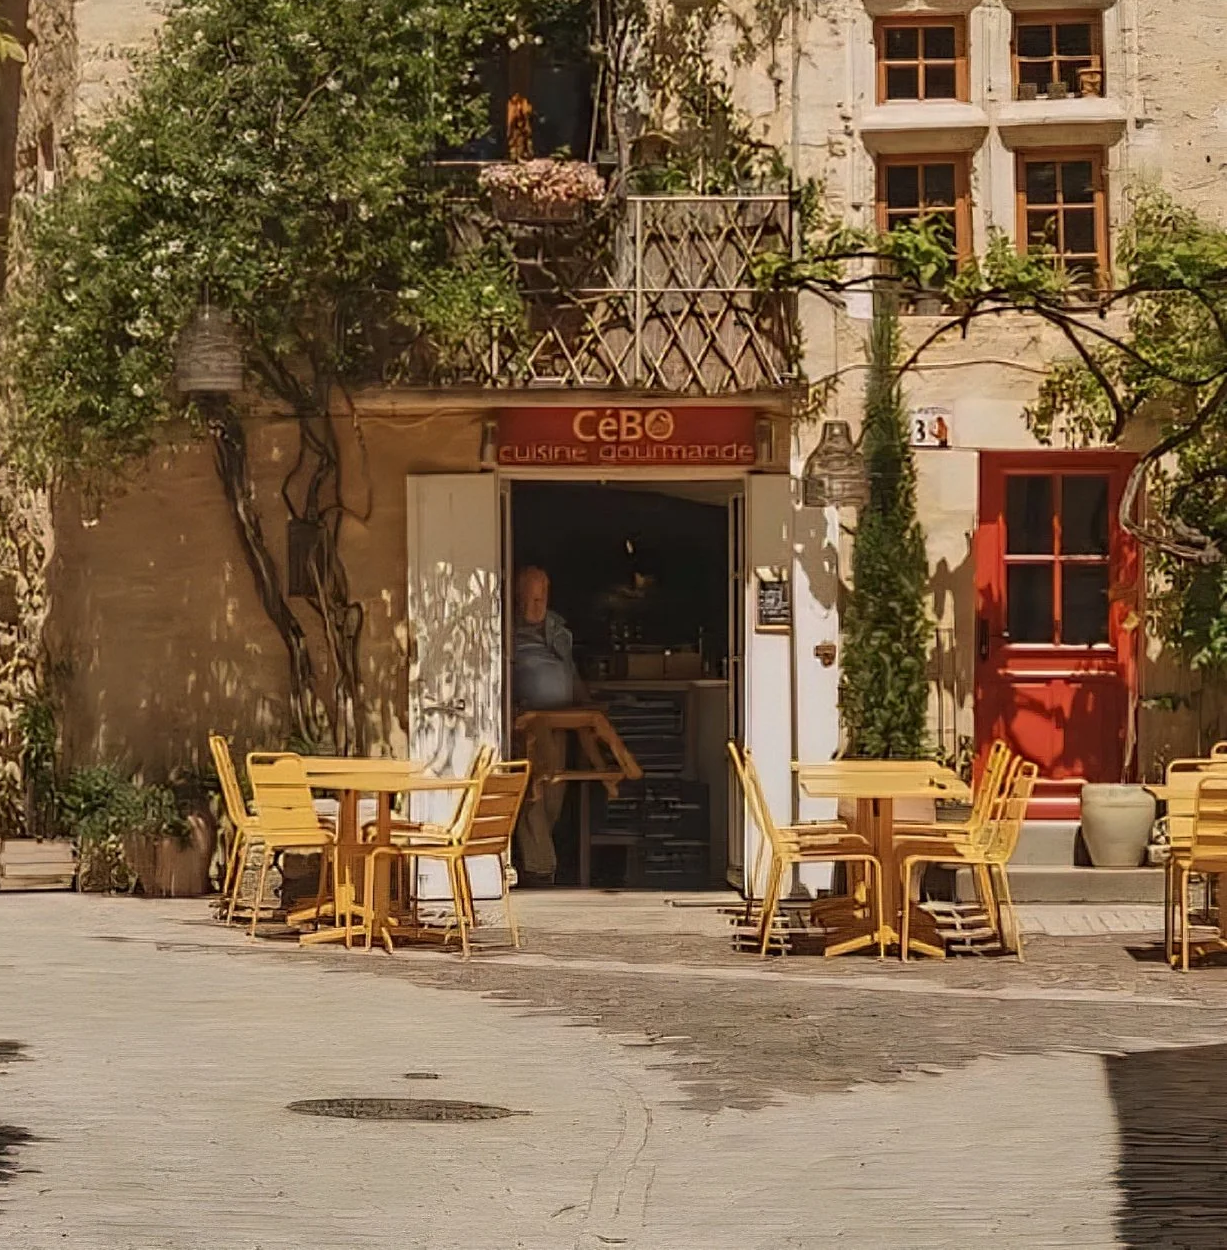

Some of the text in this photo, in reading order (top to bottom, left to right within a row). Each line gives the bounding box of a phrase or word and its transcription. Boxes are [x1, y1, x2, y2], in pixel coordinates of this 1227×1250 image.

[915, 419, 926, 442] 3
[499, 442, 755, 463] cuisine gourmande
